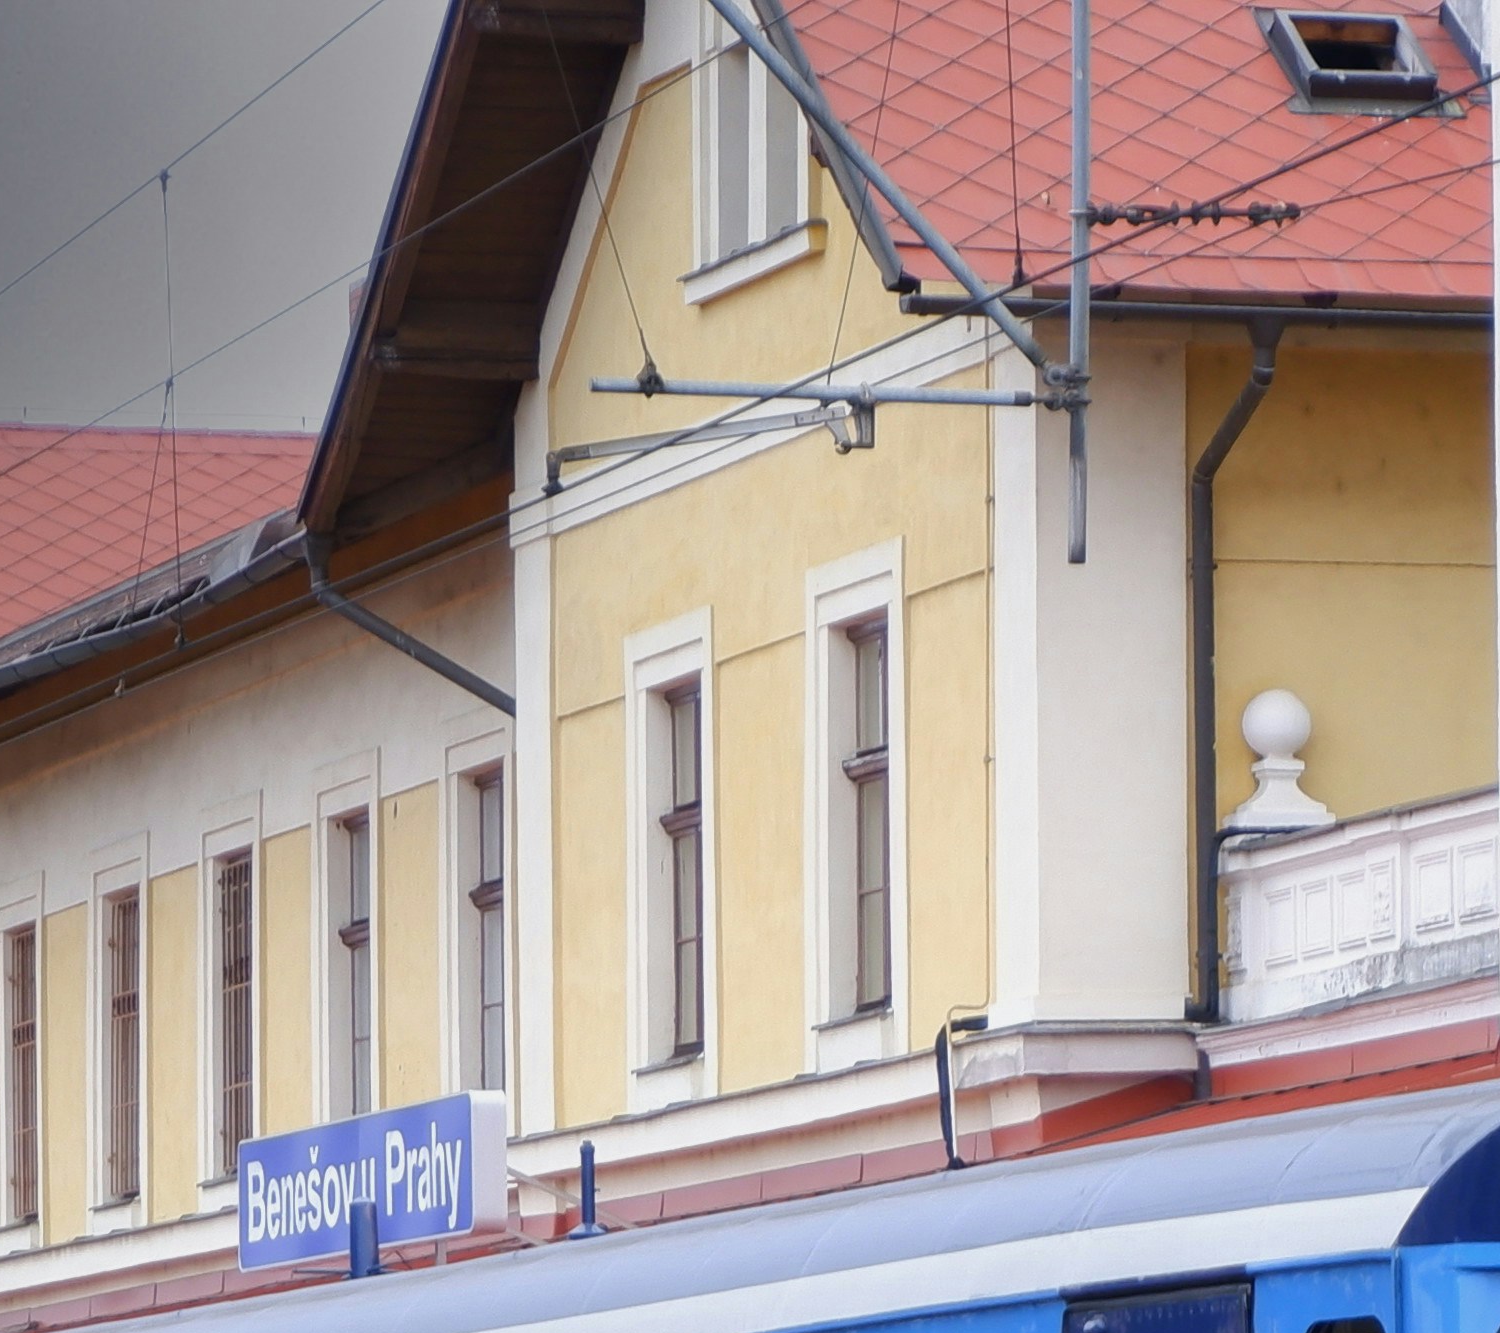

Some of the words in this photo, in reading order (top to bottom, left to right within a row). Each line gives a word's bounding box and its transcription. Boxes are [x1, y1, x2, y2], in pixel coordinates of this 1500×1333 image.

[247, 1145, 356, 1243] Benešov
[361, 1157, 376, 1201] u
[385, 1121, 462, 1230] Prahy
